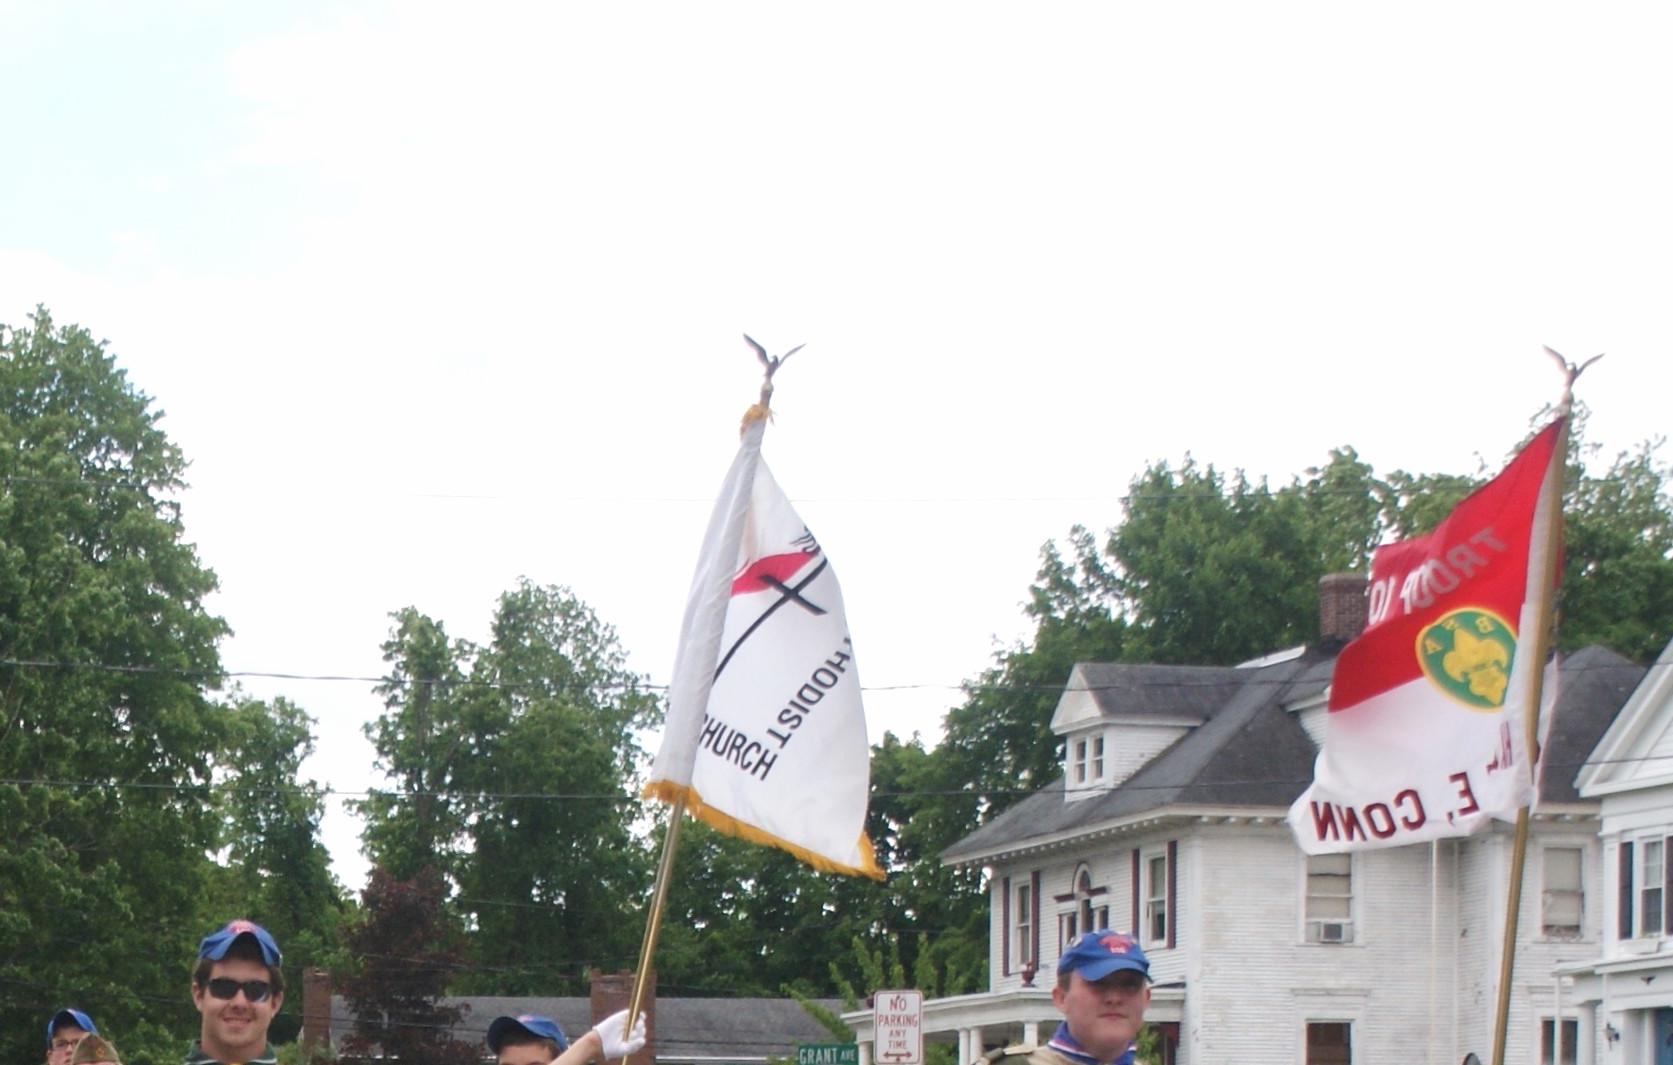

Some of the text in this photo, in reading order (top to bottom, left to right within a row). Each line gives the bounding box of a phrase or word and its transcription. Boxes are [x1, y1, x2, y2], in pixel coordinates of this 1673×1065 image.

[698, 713, 778, 781] HURCH
[889, 997, 907, 1011] NO
[878, 1014, 918, 1028] PARKING
[888, 1030, 907, 1038] ANY
[888, 1040, 907, 1049] TIME
[799, 1048, 855, 1065] GRANT AVE
